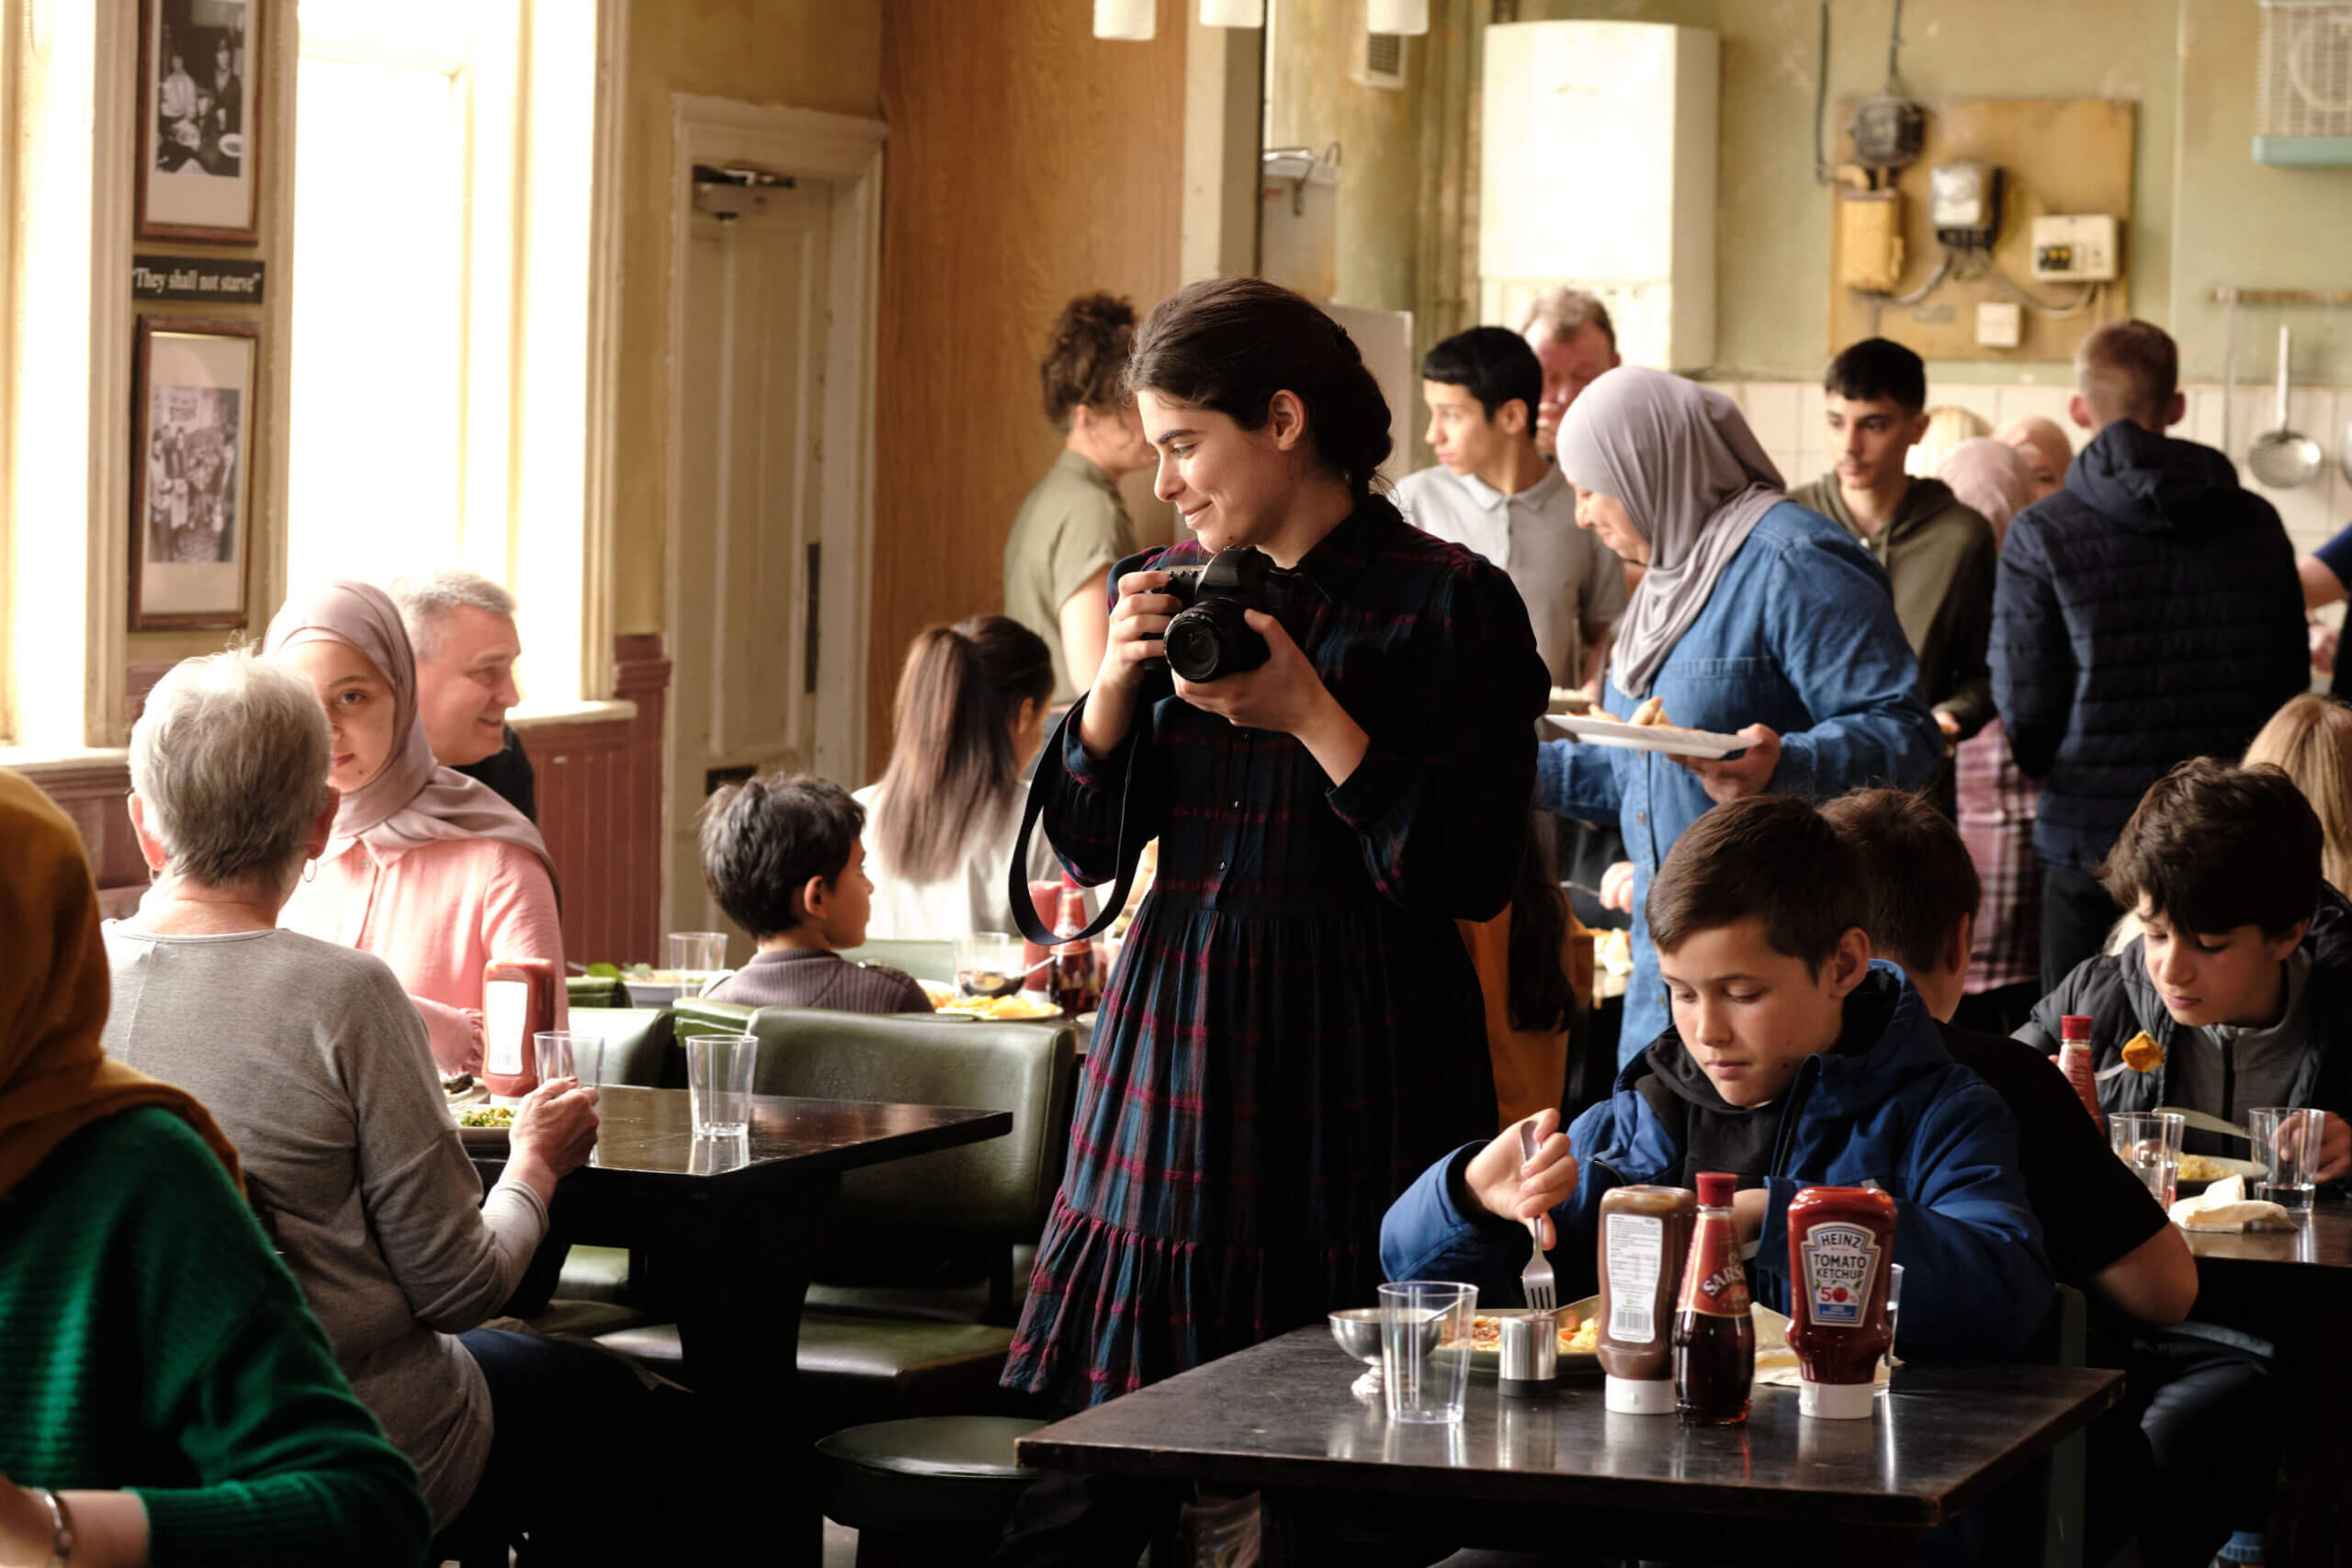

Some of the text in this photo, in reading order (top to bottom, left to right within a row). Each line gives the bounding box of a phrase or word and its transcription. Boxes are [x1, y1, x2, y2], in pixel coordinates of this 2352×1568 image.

[168, 268, 198, 290] shall
[199, 275, 220, 291] not
[1821, 1234, 1861, 1248] HEINZ
[1814, 1254, 1867, 1269] TOMATO
[1816, 1269, 1864, 1280] KETCHUP
